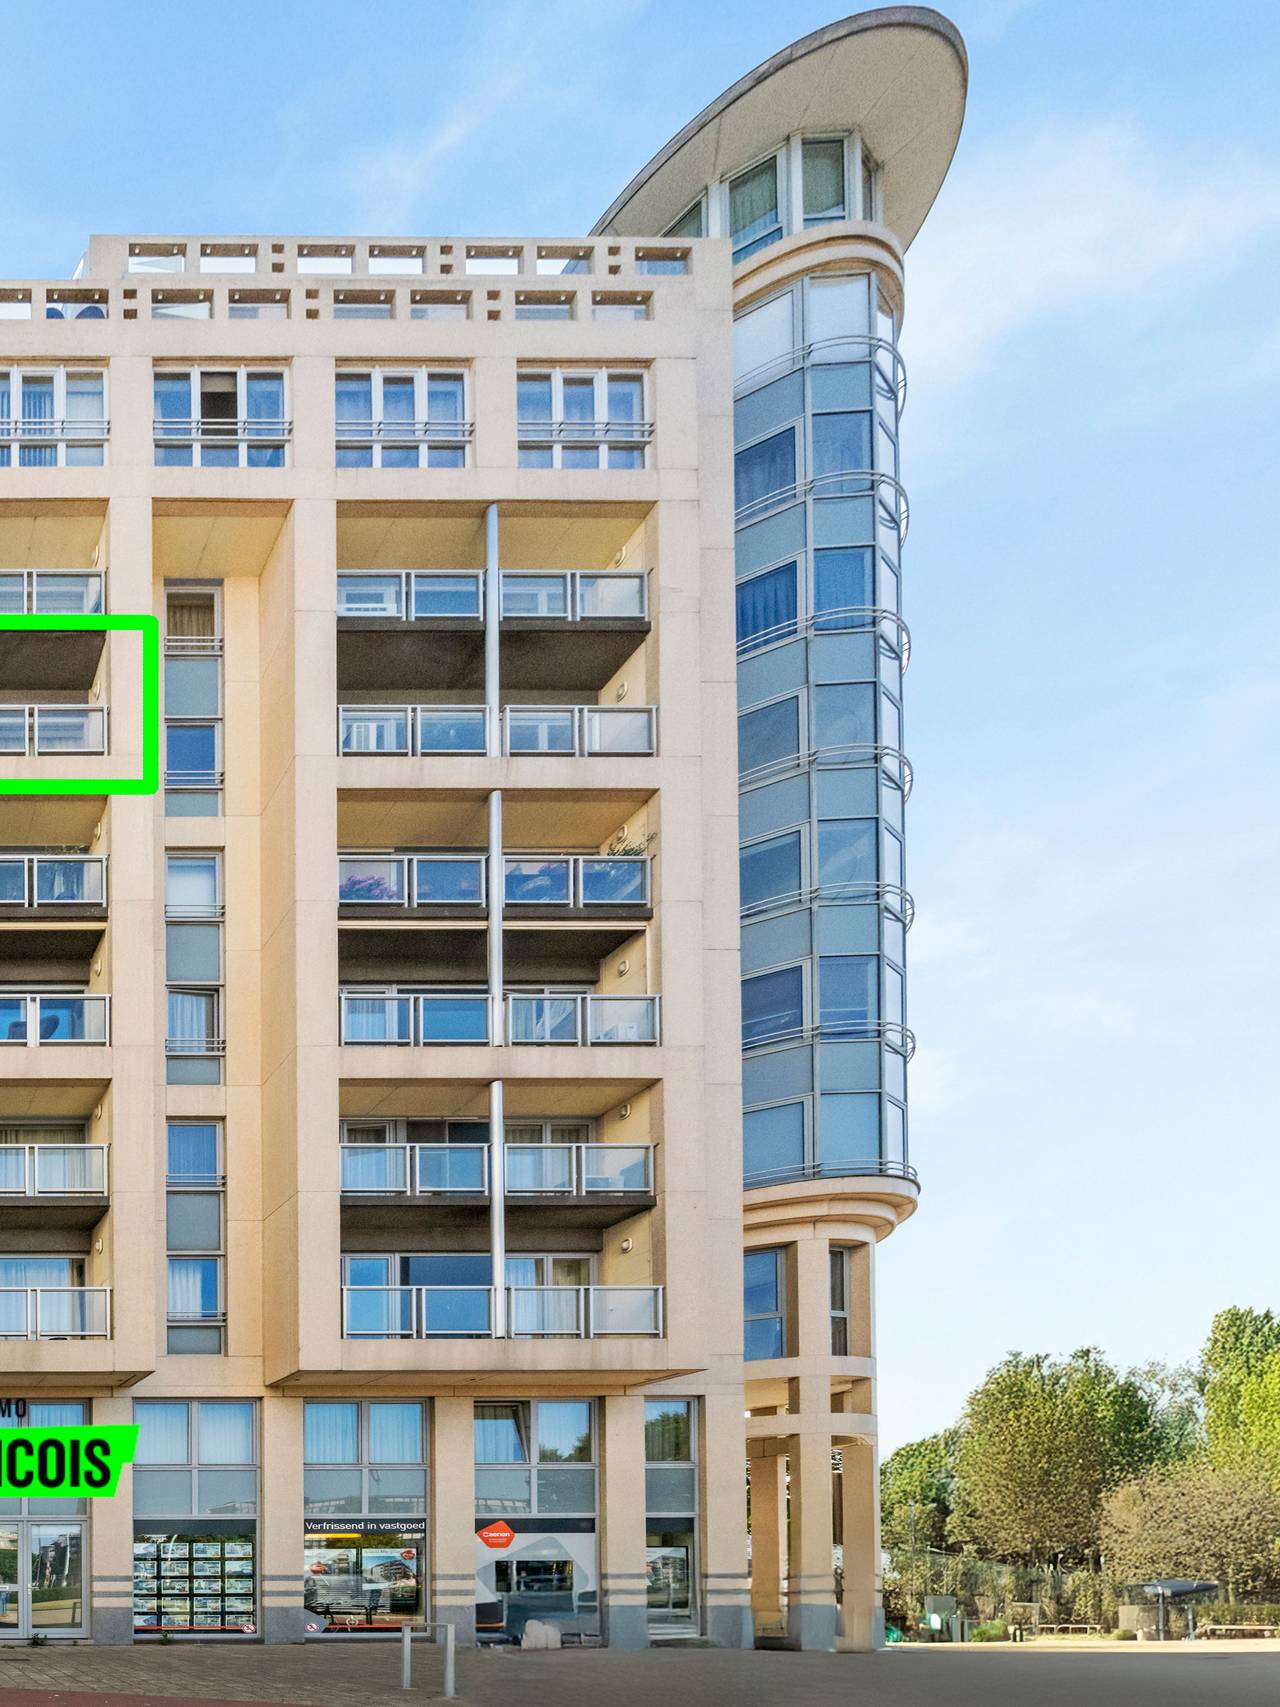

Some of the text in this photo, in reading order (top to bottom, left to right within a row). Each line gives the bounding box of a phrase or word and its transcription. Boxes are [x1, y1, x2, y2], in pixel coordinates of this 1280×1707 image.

[305, 1521, 425, 1531] Verfrissend in vastgoed
